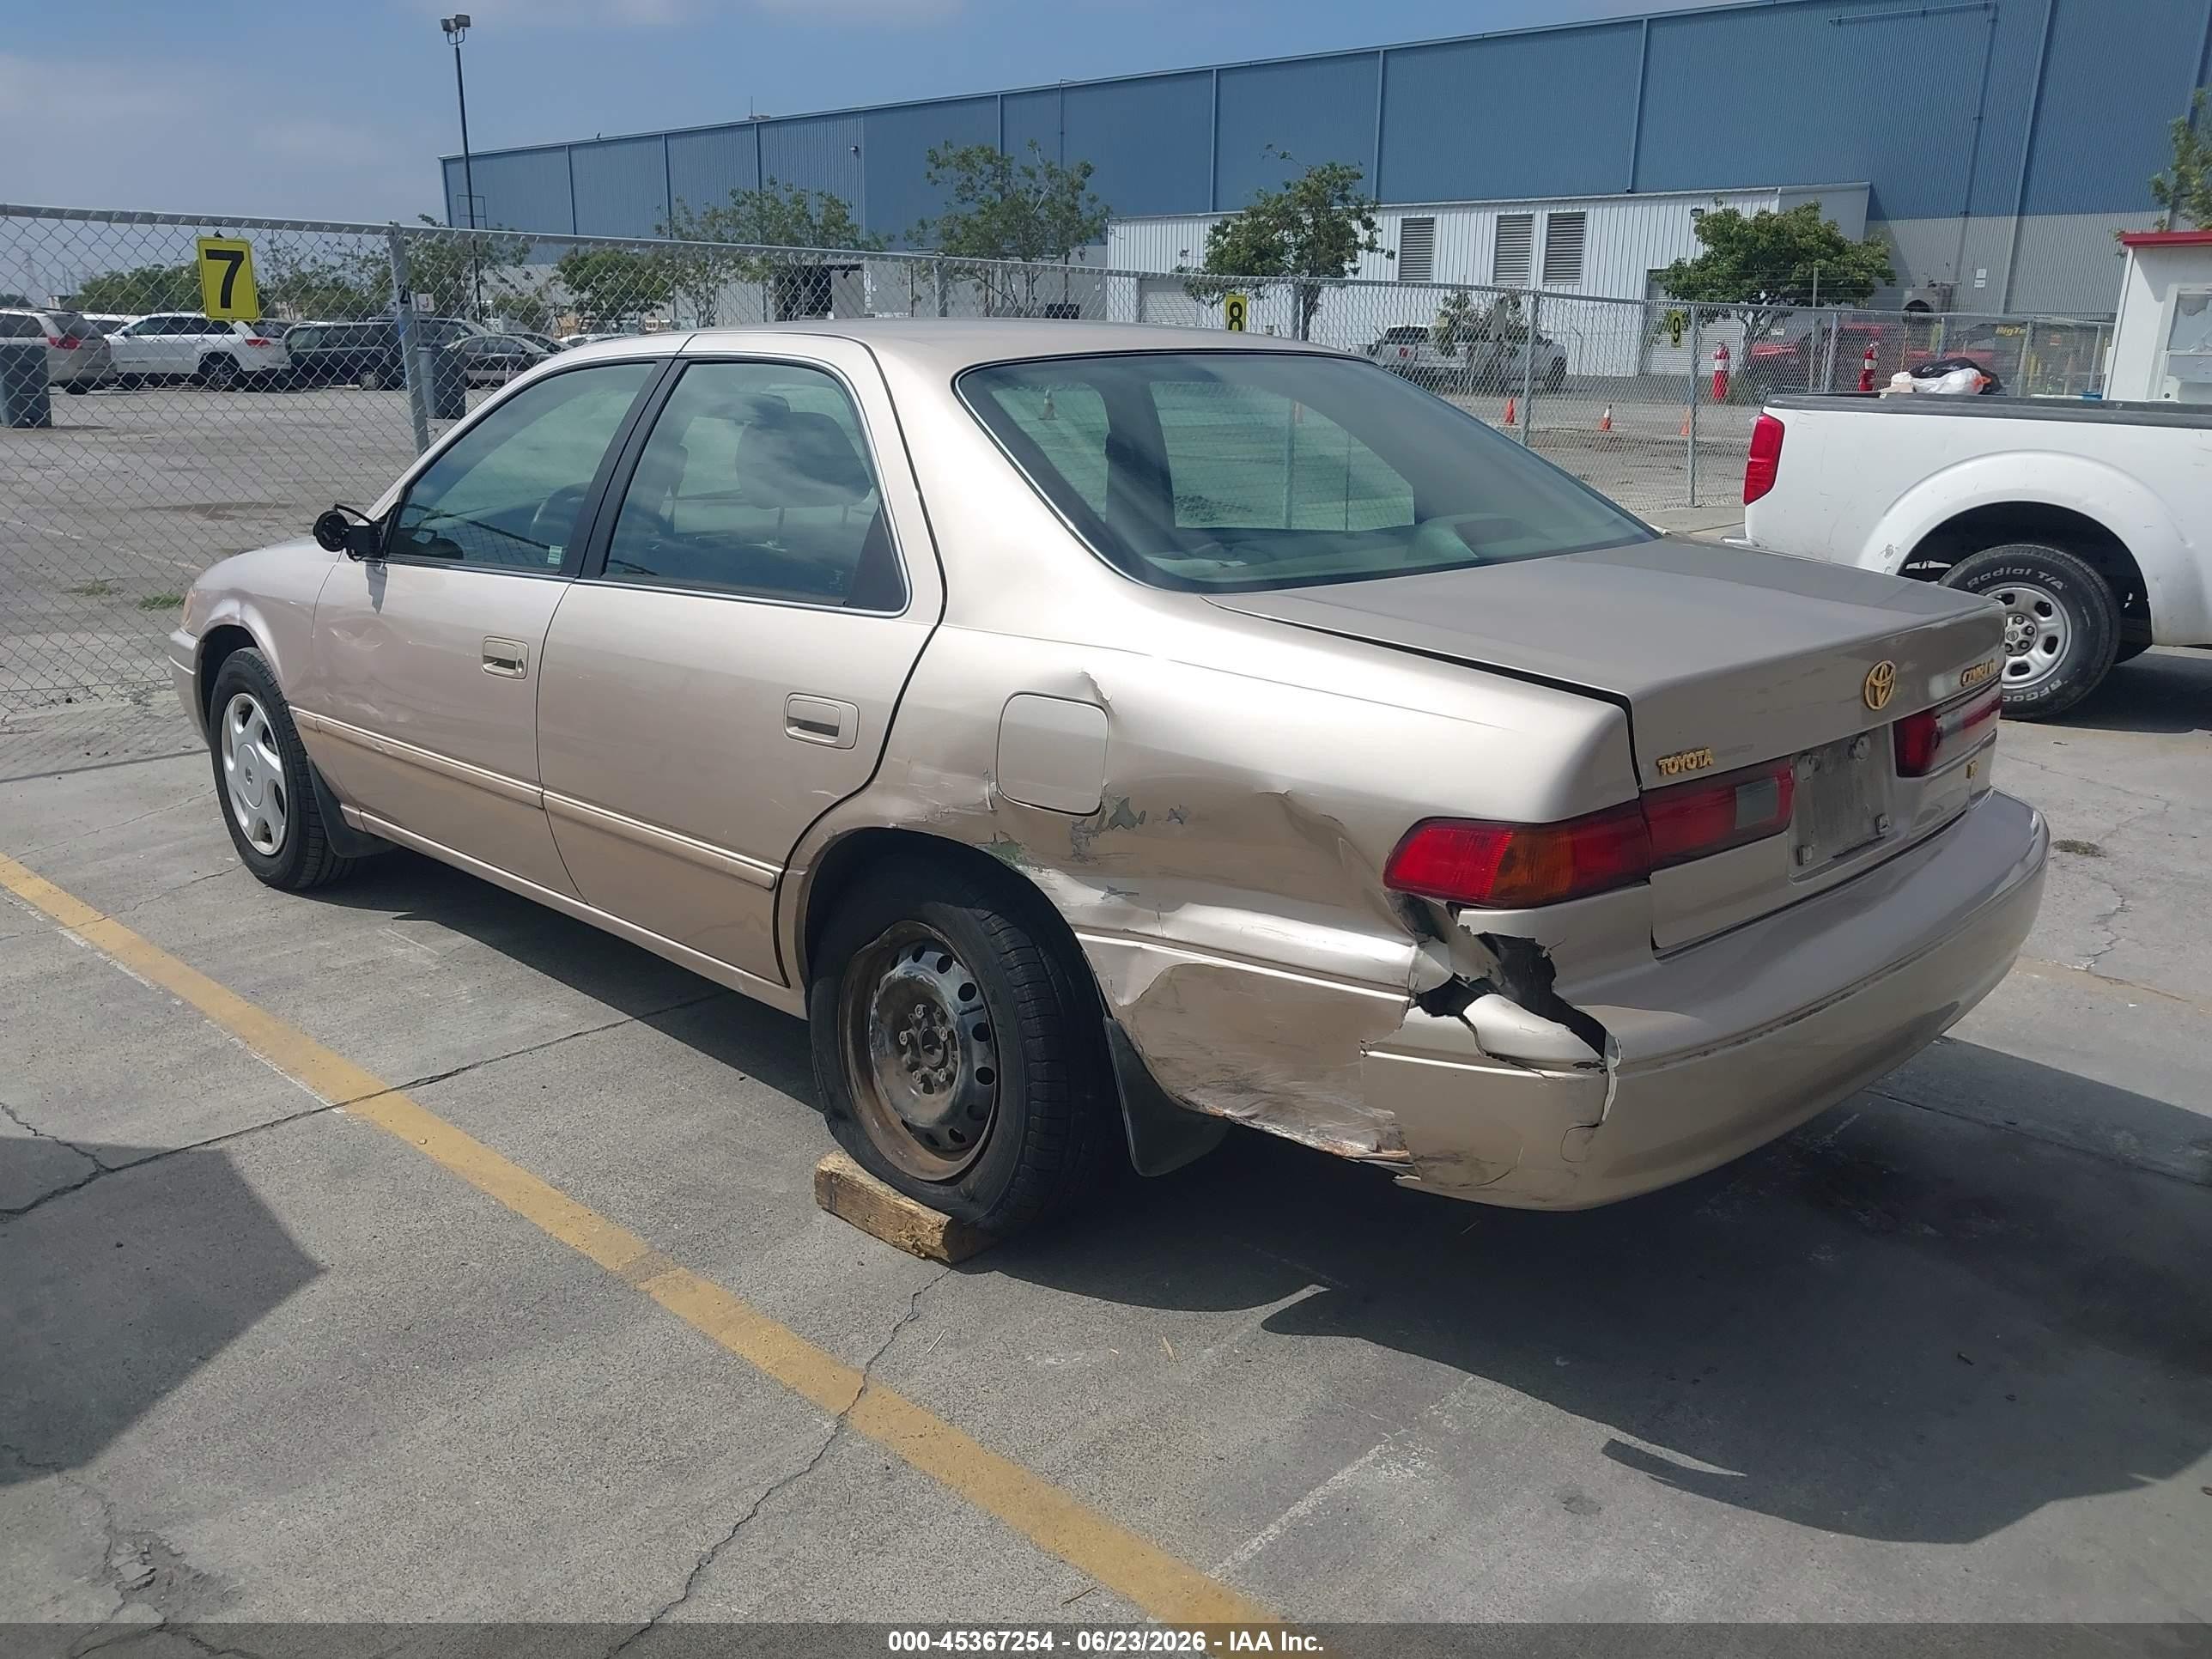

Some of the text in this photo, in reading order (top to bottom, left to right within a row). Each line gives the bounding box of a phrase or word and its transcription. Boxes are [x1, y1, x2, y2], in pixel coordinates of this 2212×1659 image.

[205, 249, 244, 309] 7
[1228, 301, 1243, 331] 8
[1673, 317, 1680, 343] 9
[1967, 567, 2063, 590] Radial T/A
[1658, 748, 1713, 776] TOYOTA
